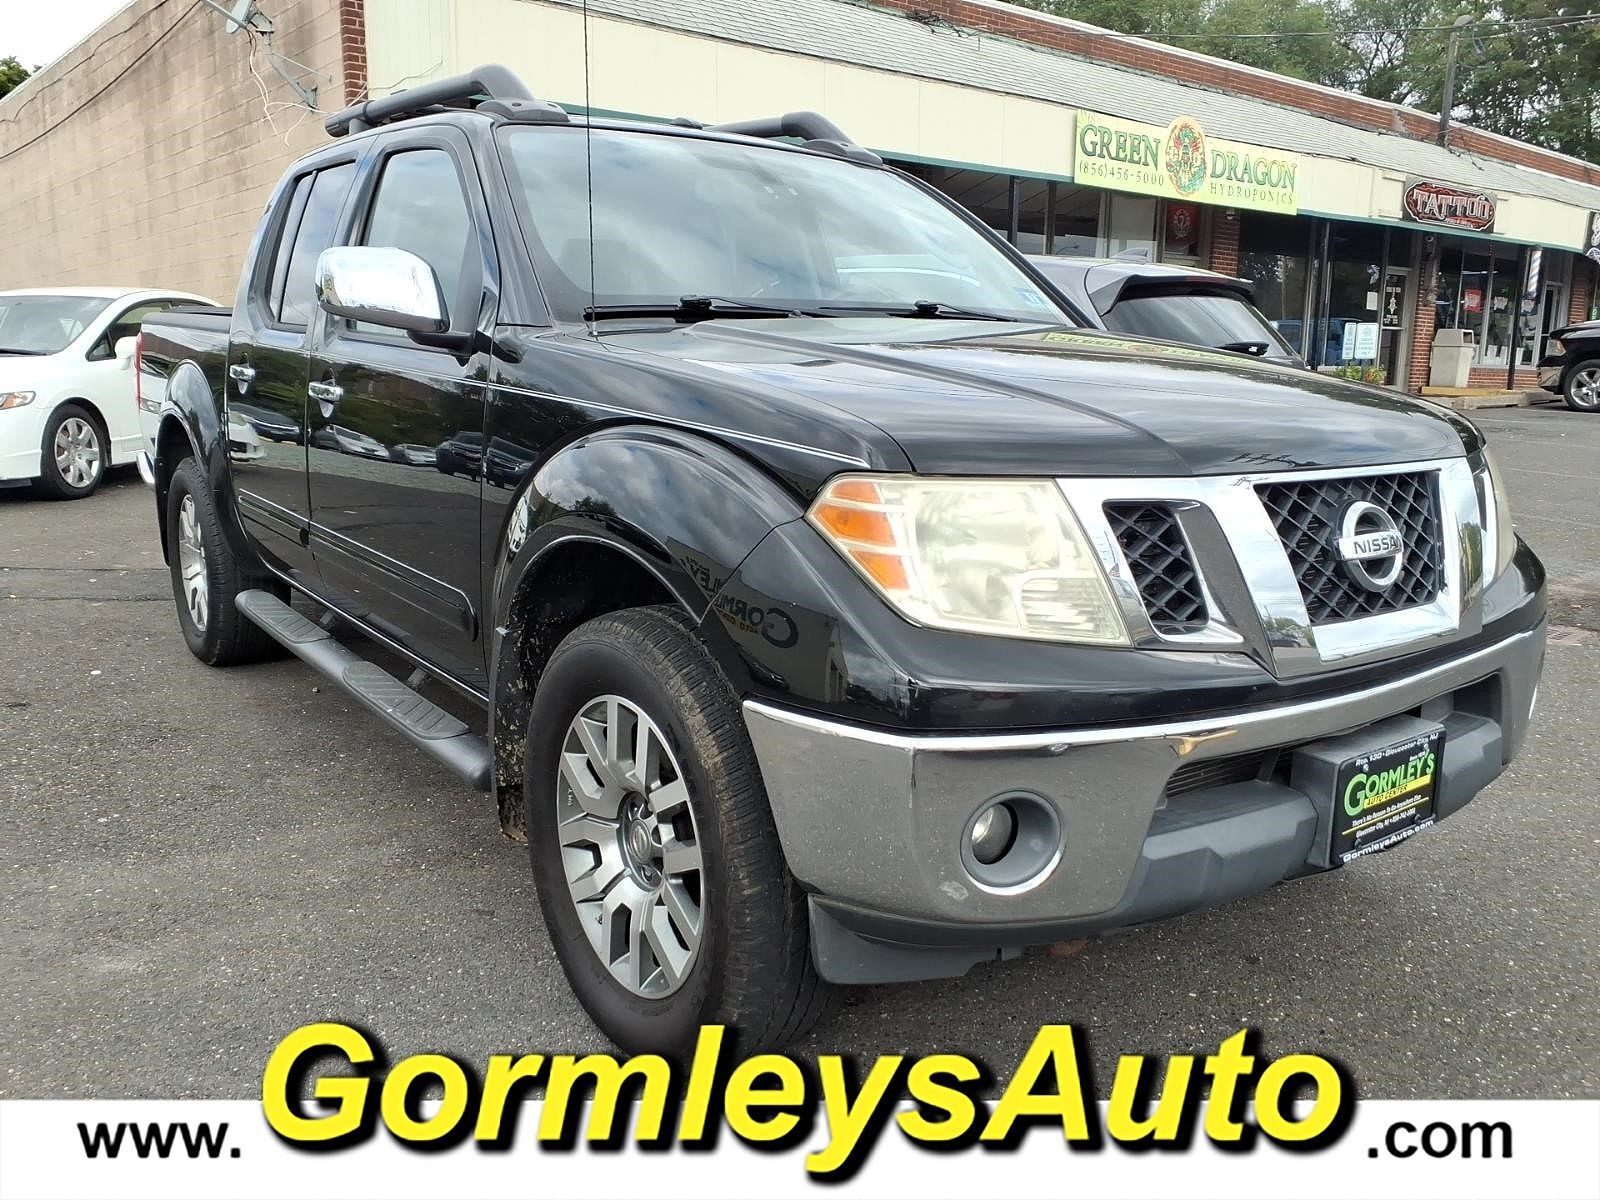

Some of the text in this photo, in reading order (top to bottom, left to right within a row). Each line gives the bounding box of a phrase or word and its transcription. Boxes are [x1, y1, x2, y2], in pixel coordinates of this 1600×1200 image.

[1080, 124, 1297, 193] GREEN DRAGON
[1210, 182, 1293, 205] HYDROPONICS
[1413, 188, 1491, 220] TATTOO
[1344, 749, 1435, 817] GORMLEY'S
